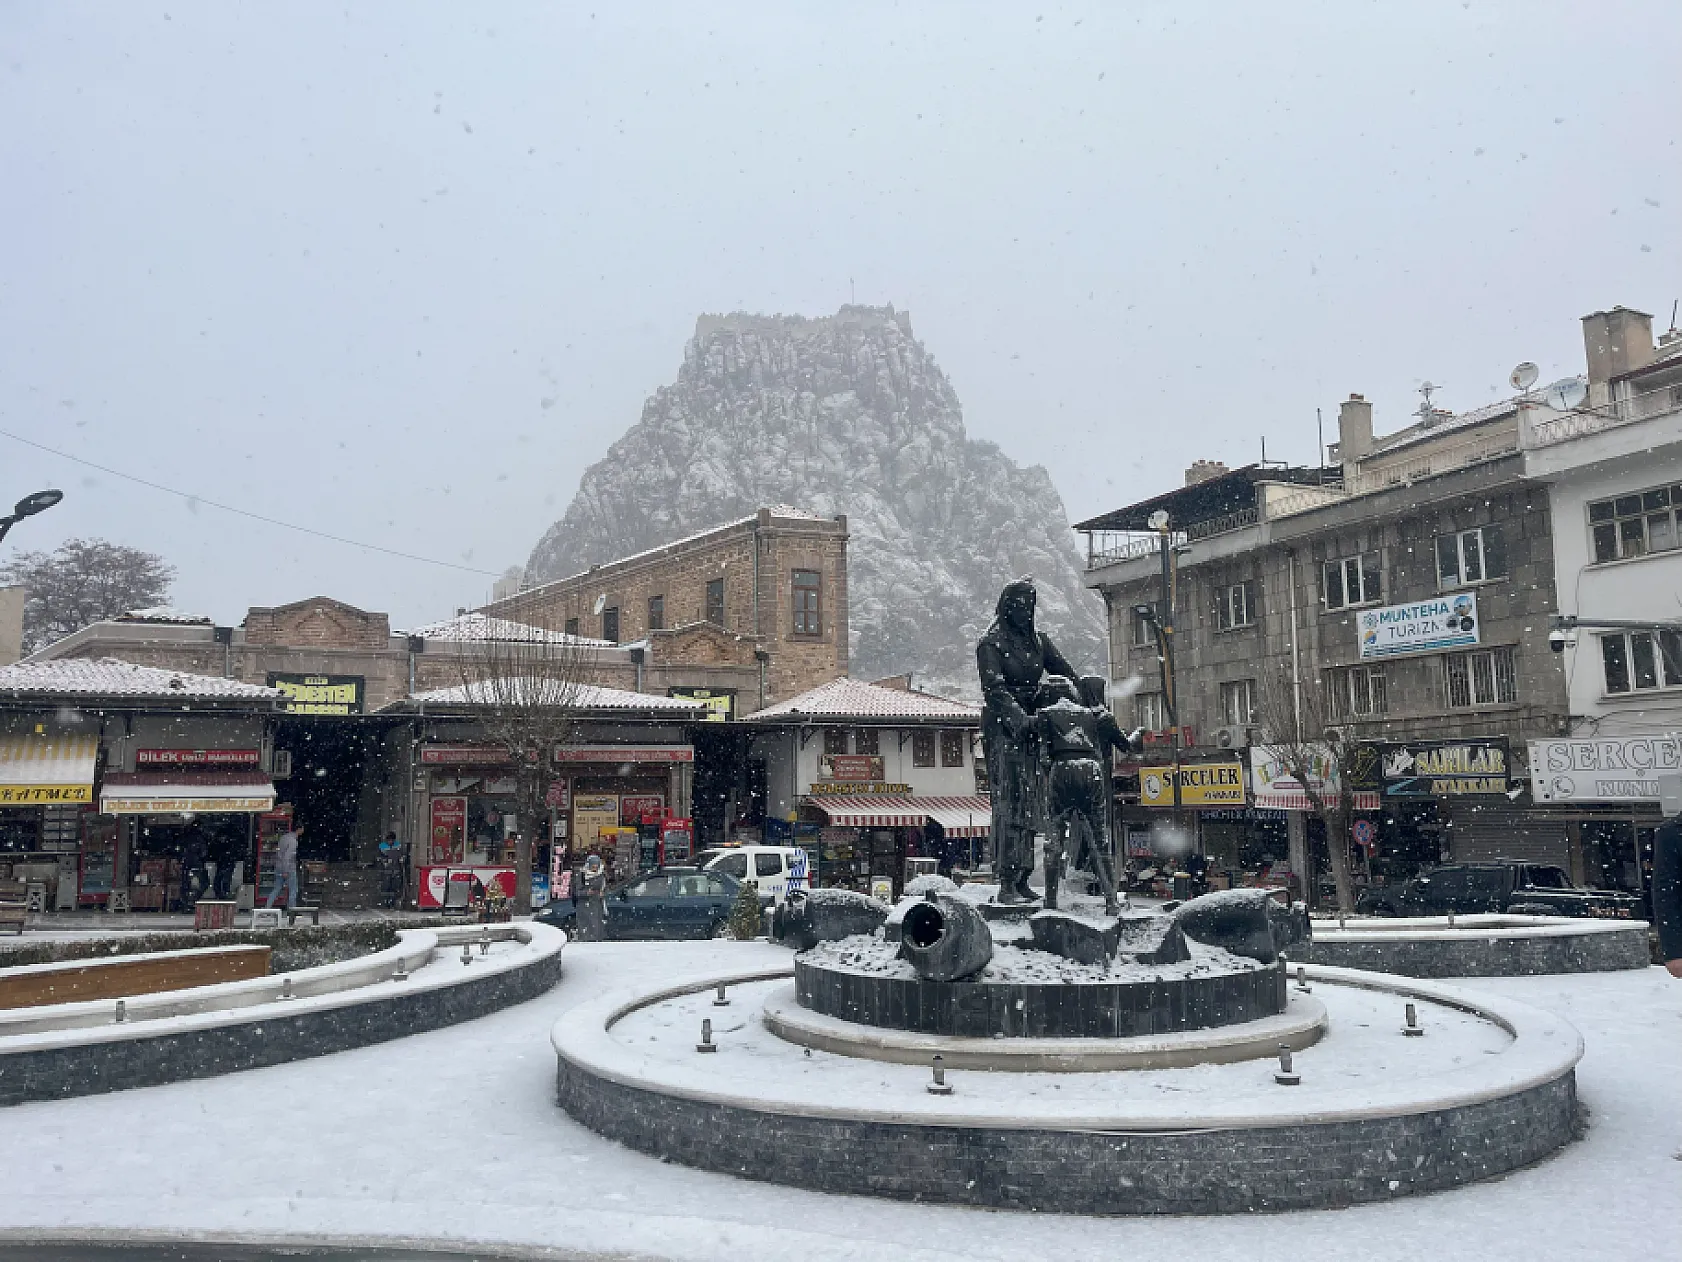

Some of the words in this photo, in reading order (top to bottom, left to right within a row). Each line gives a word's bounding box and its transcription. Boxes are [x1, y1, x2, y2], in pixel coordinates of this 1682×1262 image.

[139, 750, 177, 762] DİLEK
[1547, 738, 1682, 777] SERÇE
[1162, 769, 1239, 790] SRÇELER
